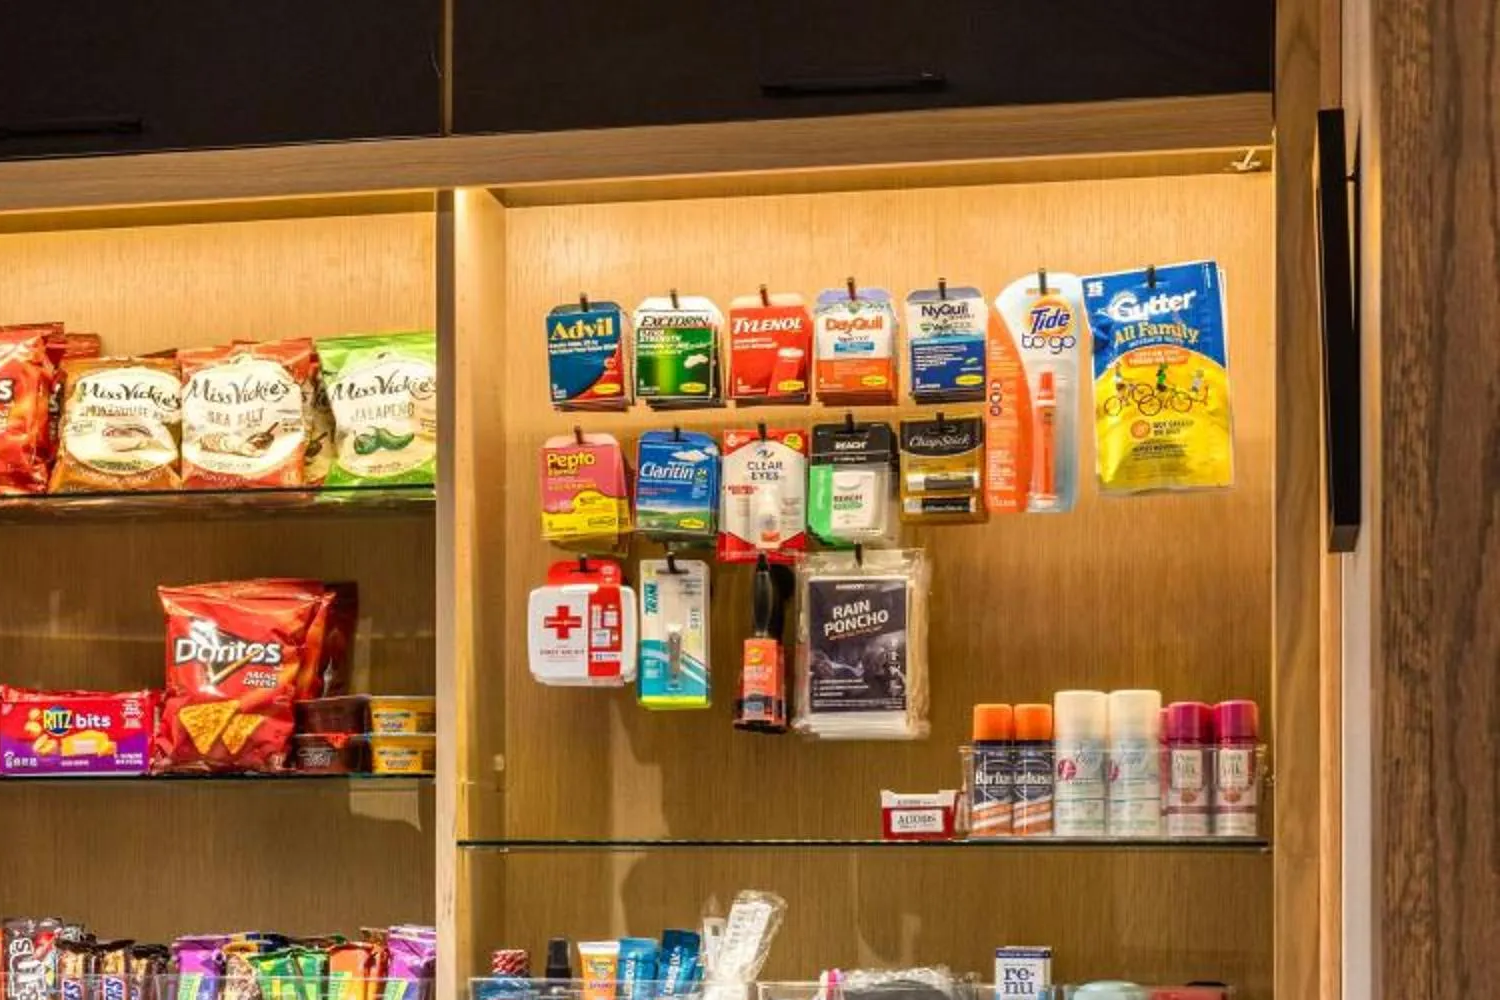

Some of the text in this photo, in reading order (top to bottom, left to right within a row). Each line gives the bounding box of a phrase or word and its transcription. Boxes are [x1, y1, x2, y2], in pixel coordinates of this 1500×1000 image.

[551, 317, 613, 341] Advil
[732, 316, 801, 334] TYLENOL
[825, 316, 884, 335] DayQuil
[1030, 307, 1071, 335] Tide
[1138, 322, 1200, 344] Family
[1021, 333, 1077, 355] to go
[187, 377, 290, 402] Miss Vickie's
[331, 381, 376, 401] Miss
[908, 434, 969, 449] ChapStick
[547, 453, 596, 469] Pepto
[640, 461, 694, 480] Claritin
[832, 599, 871, 619] RAIN
[823, 609, 890, 637] PONCHO
[175, 636, 281, 664] Doritos
[43, 710, 112, 730] RITZ bits
